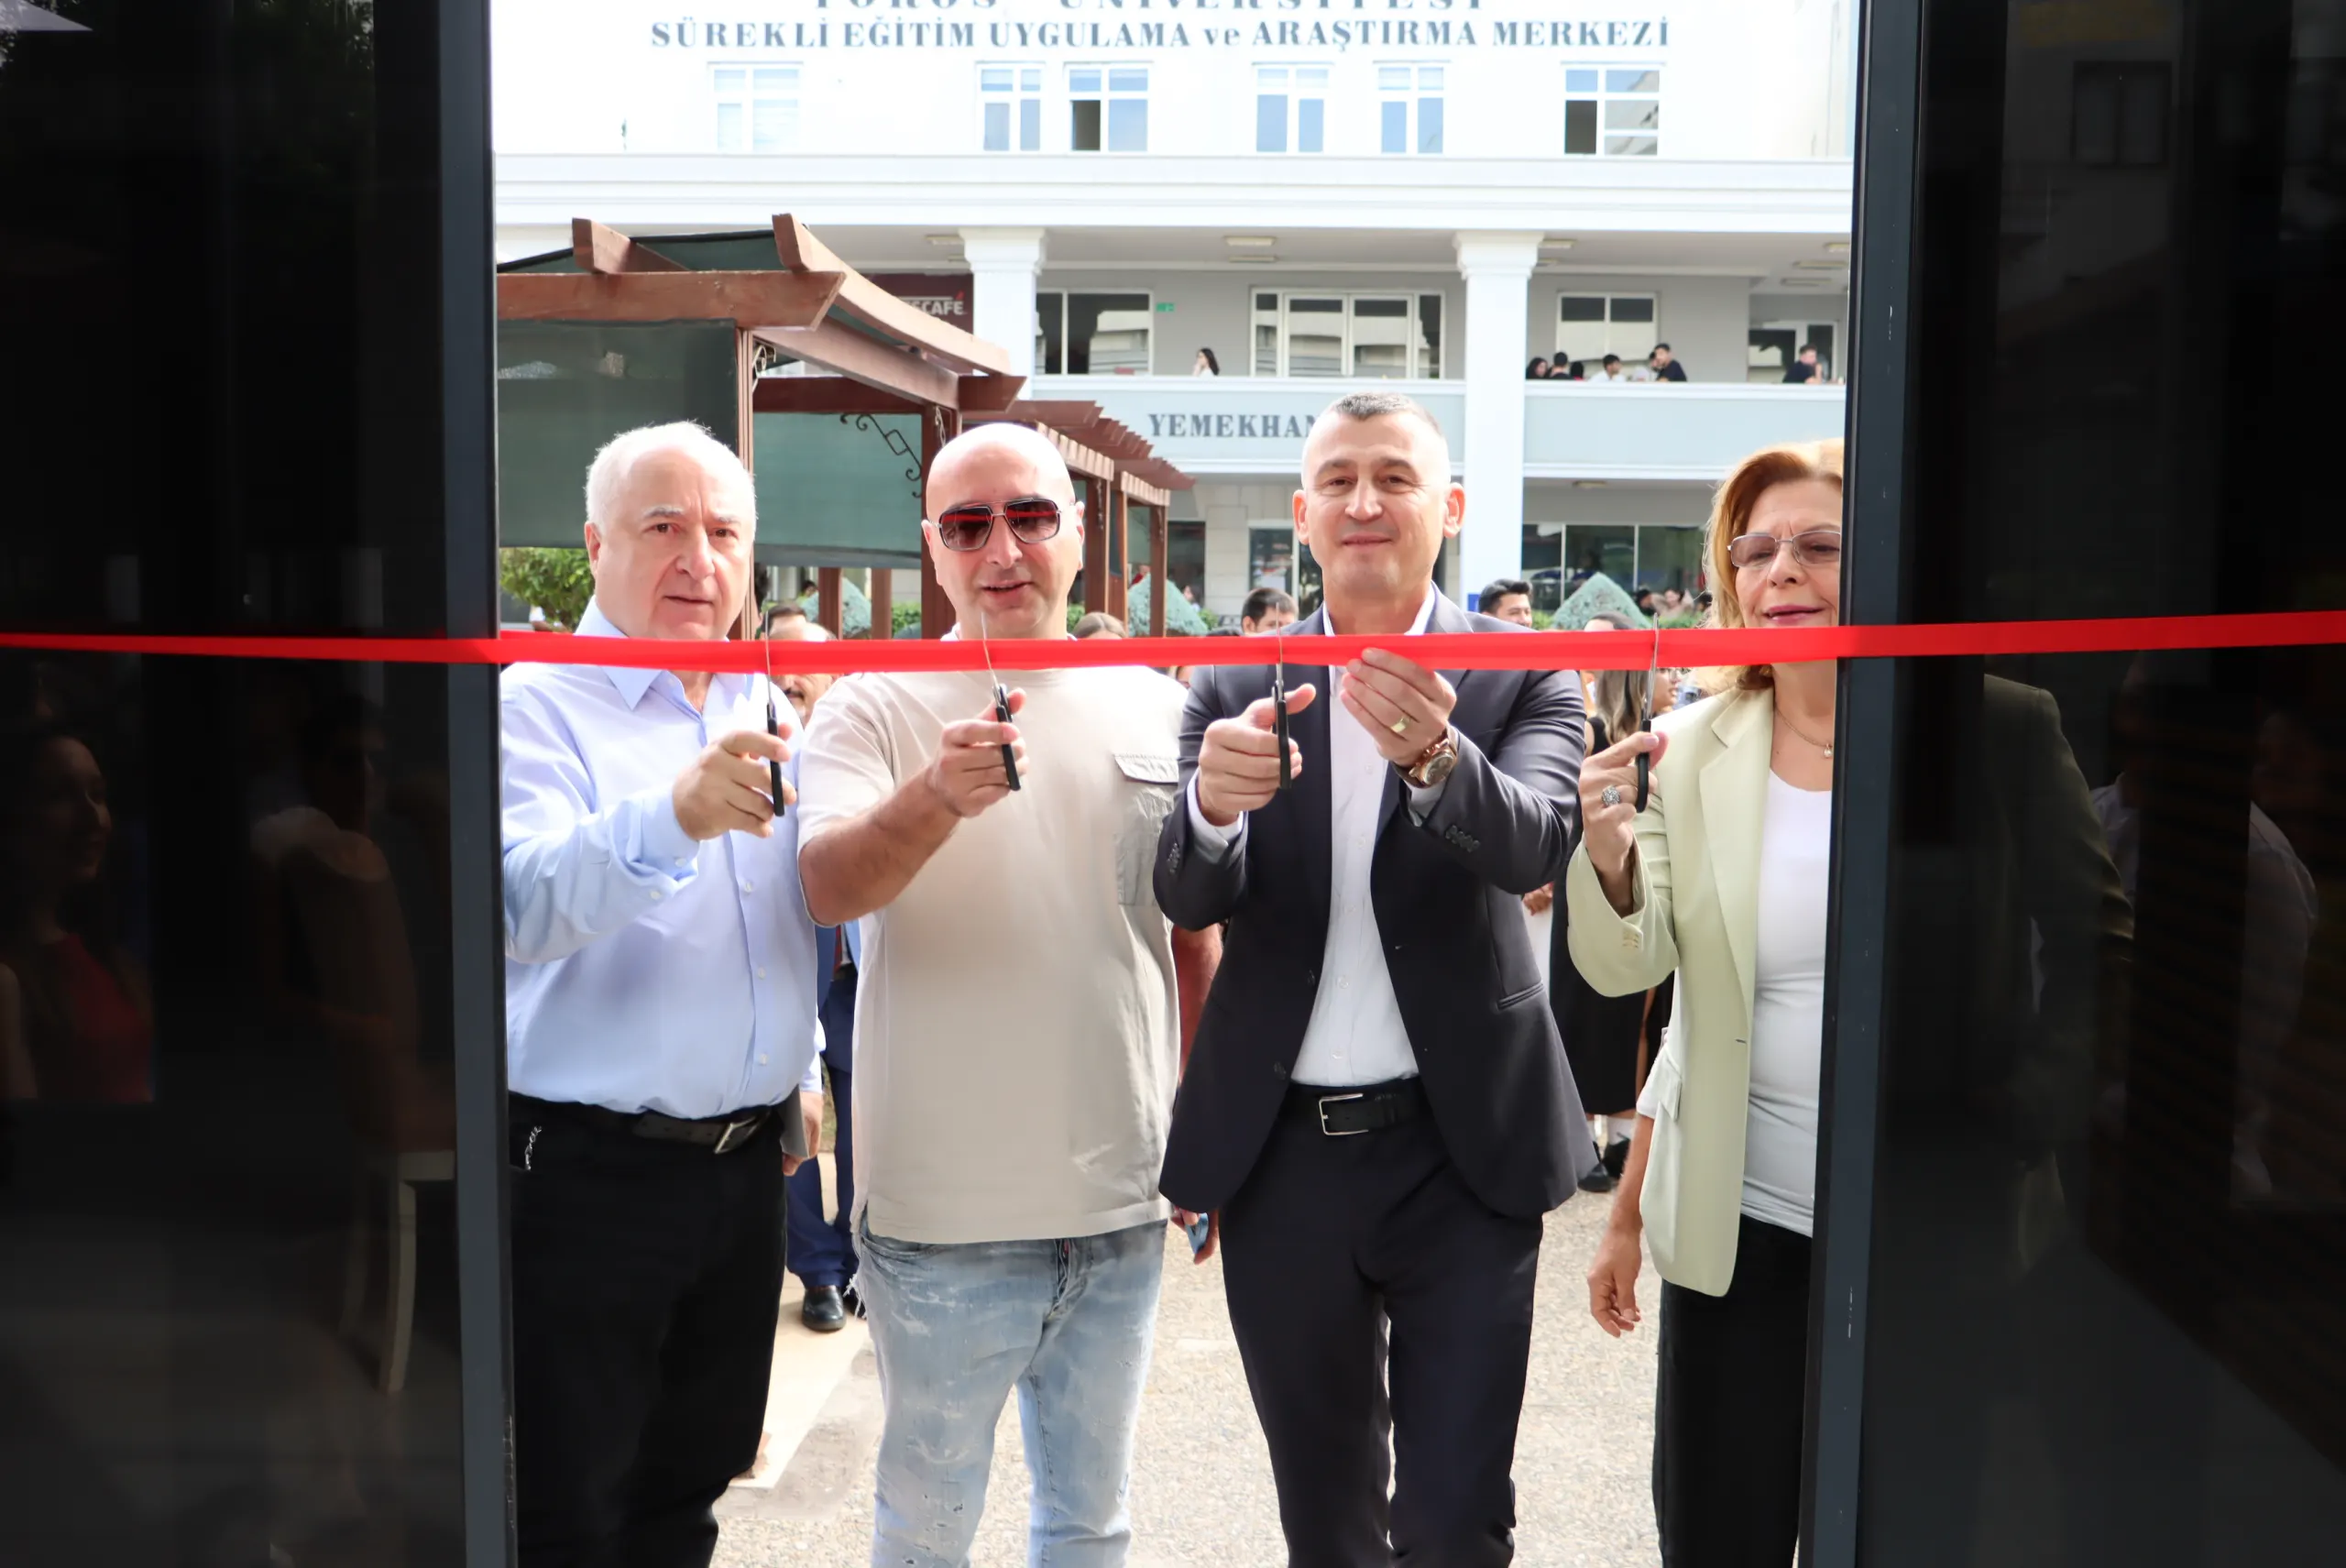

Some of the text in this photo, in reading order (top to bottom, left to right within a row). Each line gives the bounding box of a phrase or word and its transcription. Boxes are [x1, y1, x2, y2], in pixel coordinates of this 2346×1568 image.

[651, 16, 1670, 52] SÜREKLİ EĞİTİM UYGULAMA ve ARAŞTIRMA MERKEZİ
